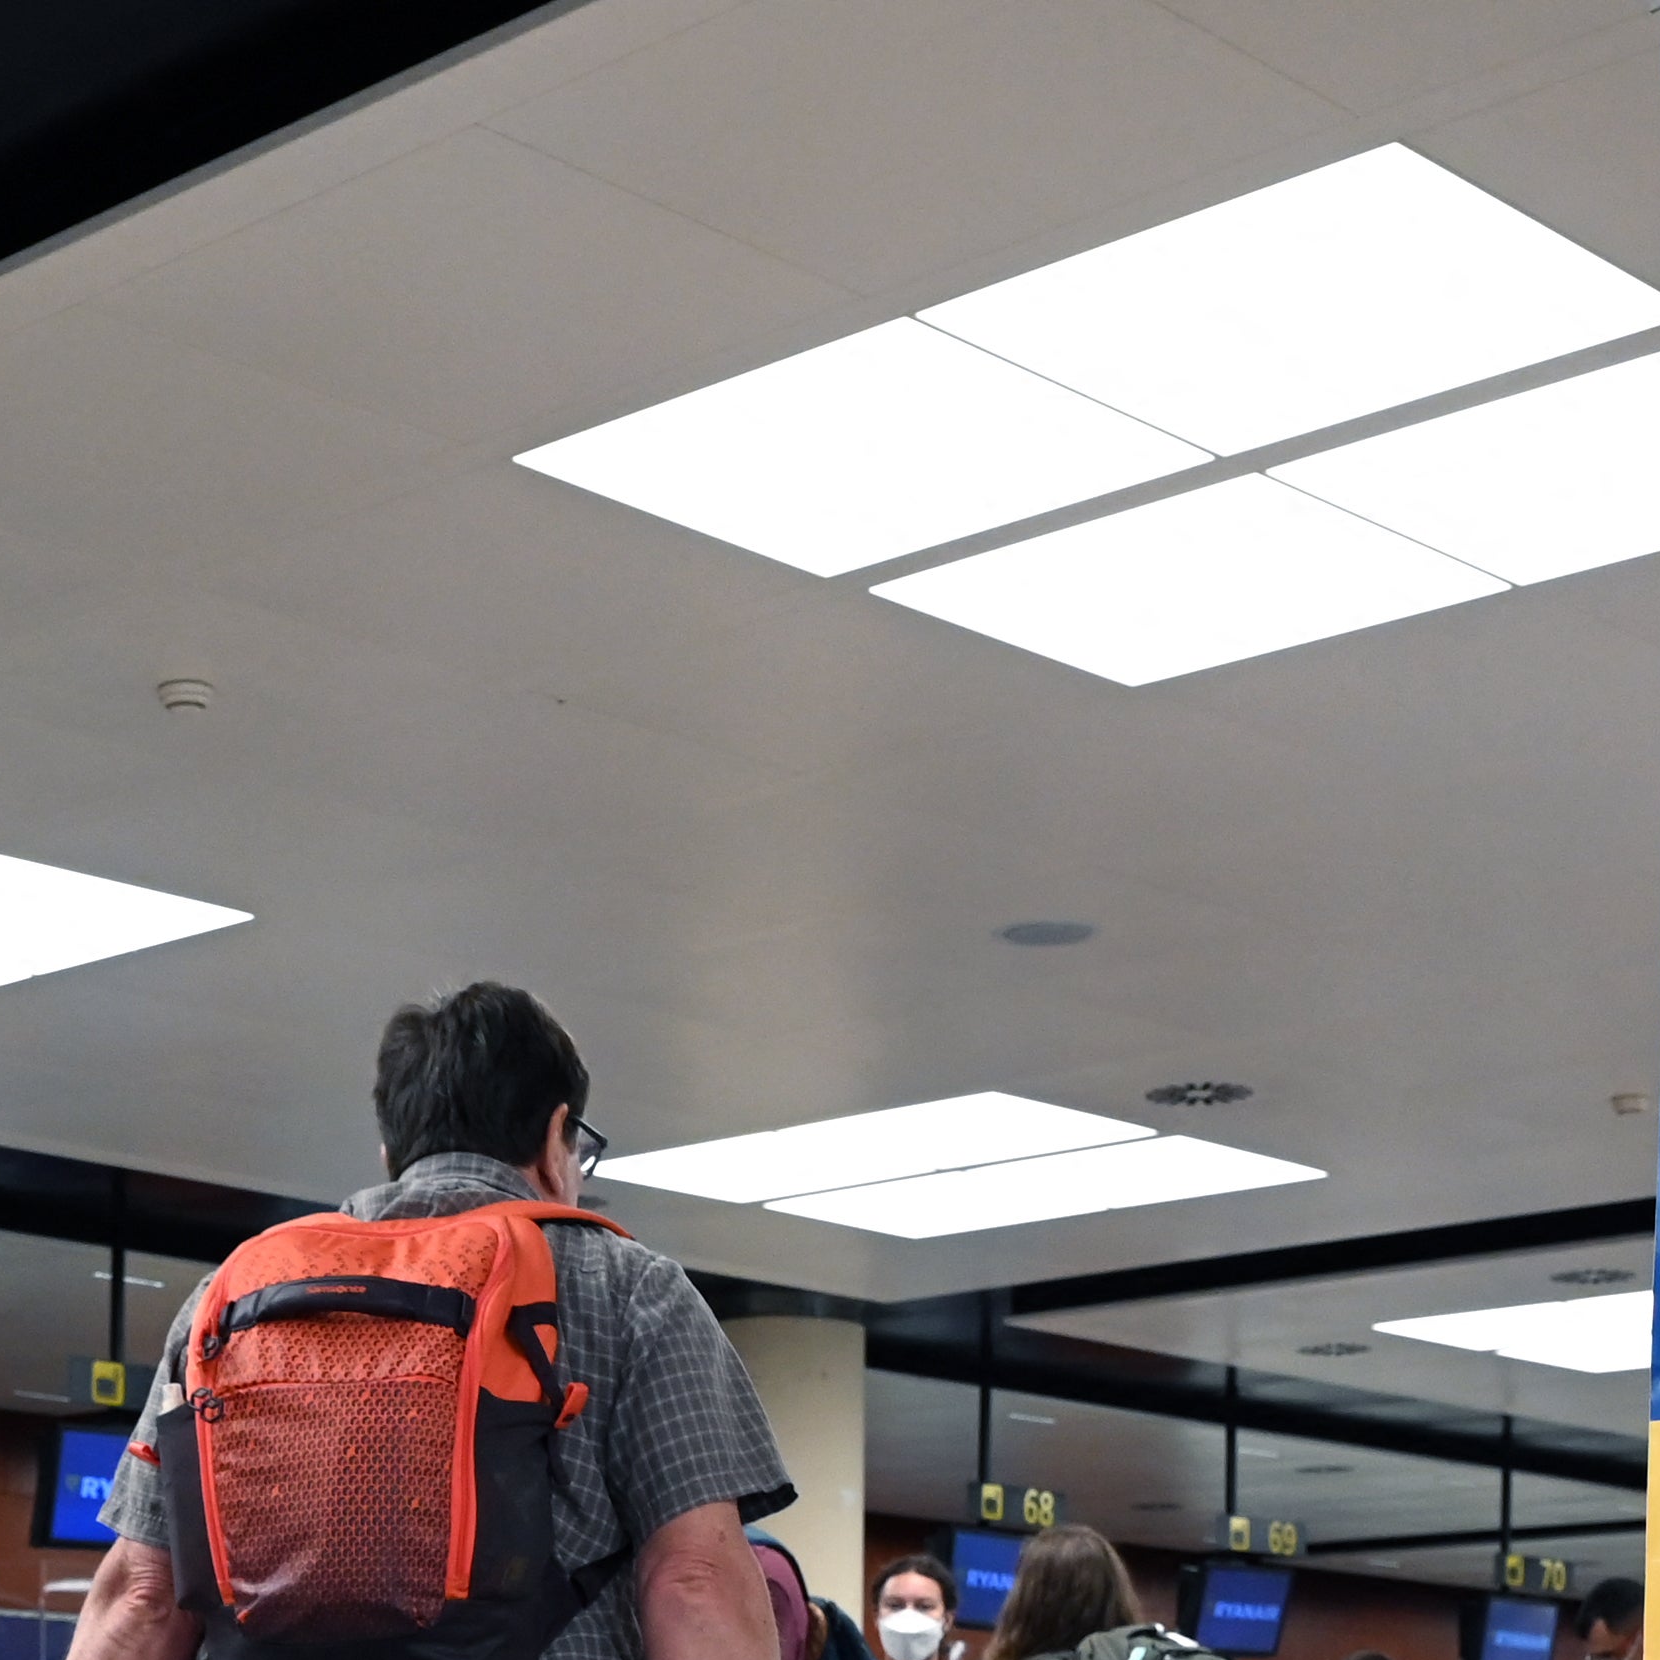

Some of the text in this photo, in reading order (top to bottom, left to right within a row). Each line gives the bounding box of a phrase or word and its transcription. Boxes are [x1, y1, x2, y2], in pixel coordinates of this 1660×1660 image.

[1023, 1488, 1055, 1527] 68
[1268, 1520, 1298, 1557] 69
[966, 1568, 1016, 1591] RYAN
[1539, 1557, 1567, 1592] 70
